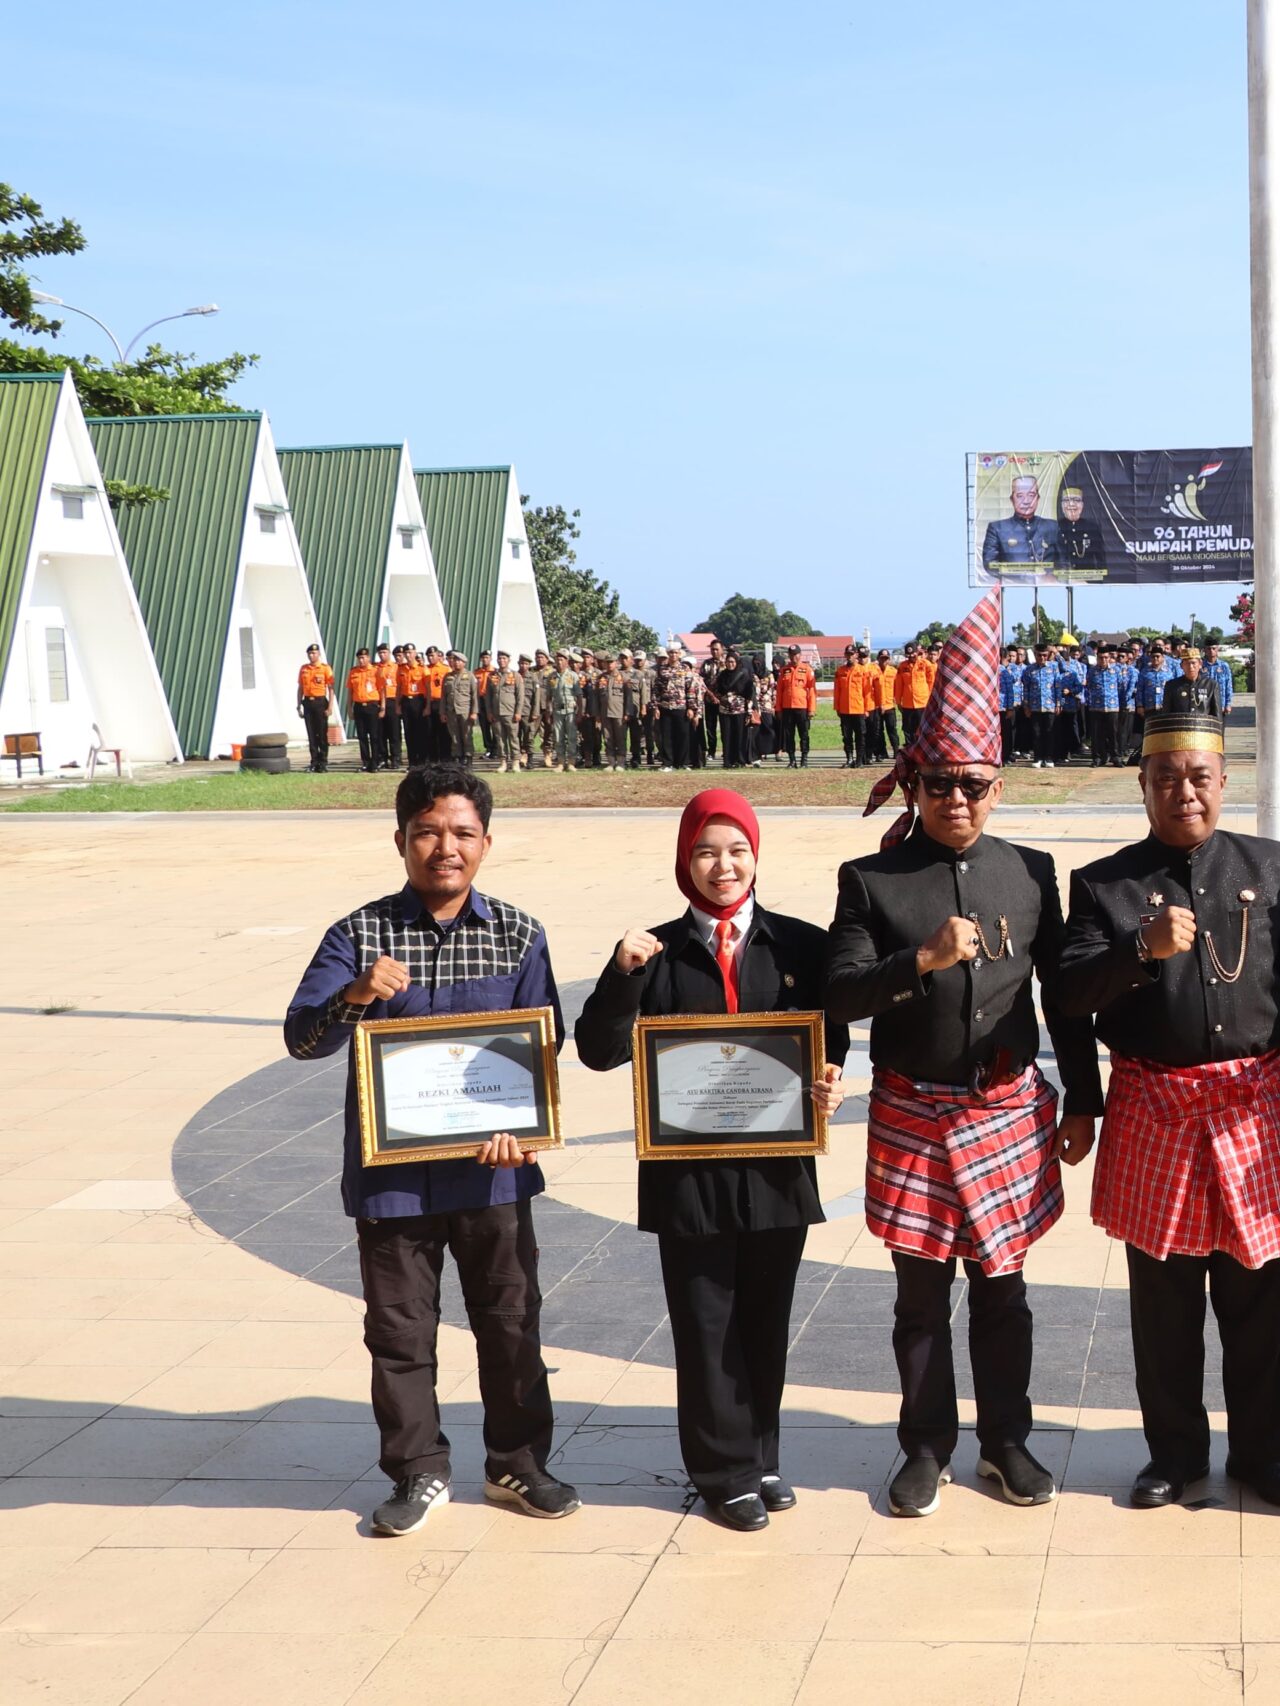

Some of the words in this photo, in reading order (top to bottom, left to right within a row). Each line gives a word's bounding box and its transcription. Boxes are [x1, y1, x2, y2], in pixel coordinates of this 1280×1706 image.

[1154, 526, 1175, 540] 96
[1178, 524, 1233, 539] TAHUN
[1125, 540, 1192, 554] SUMPAH
[1196, 537, 1254, 551] PEMUD
[1136, 554, 1156, 562] MAJU
[1158, 553, 1192, 561] BERSAMA
[1193, 552, 1232, 560] INDONESIA
[418, 1089, 450, 1098] REZKI
[453, 1084, 501, 1096] AMALIAH
